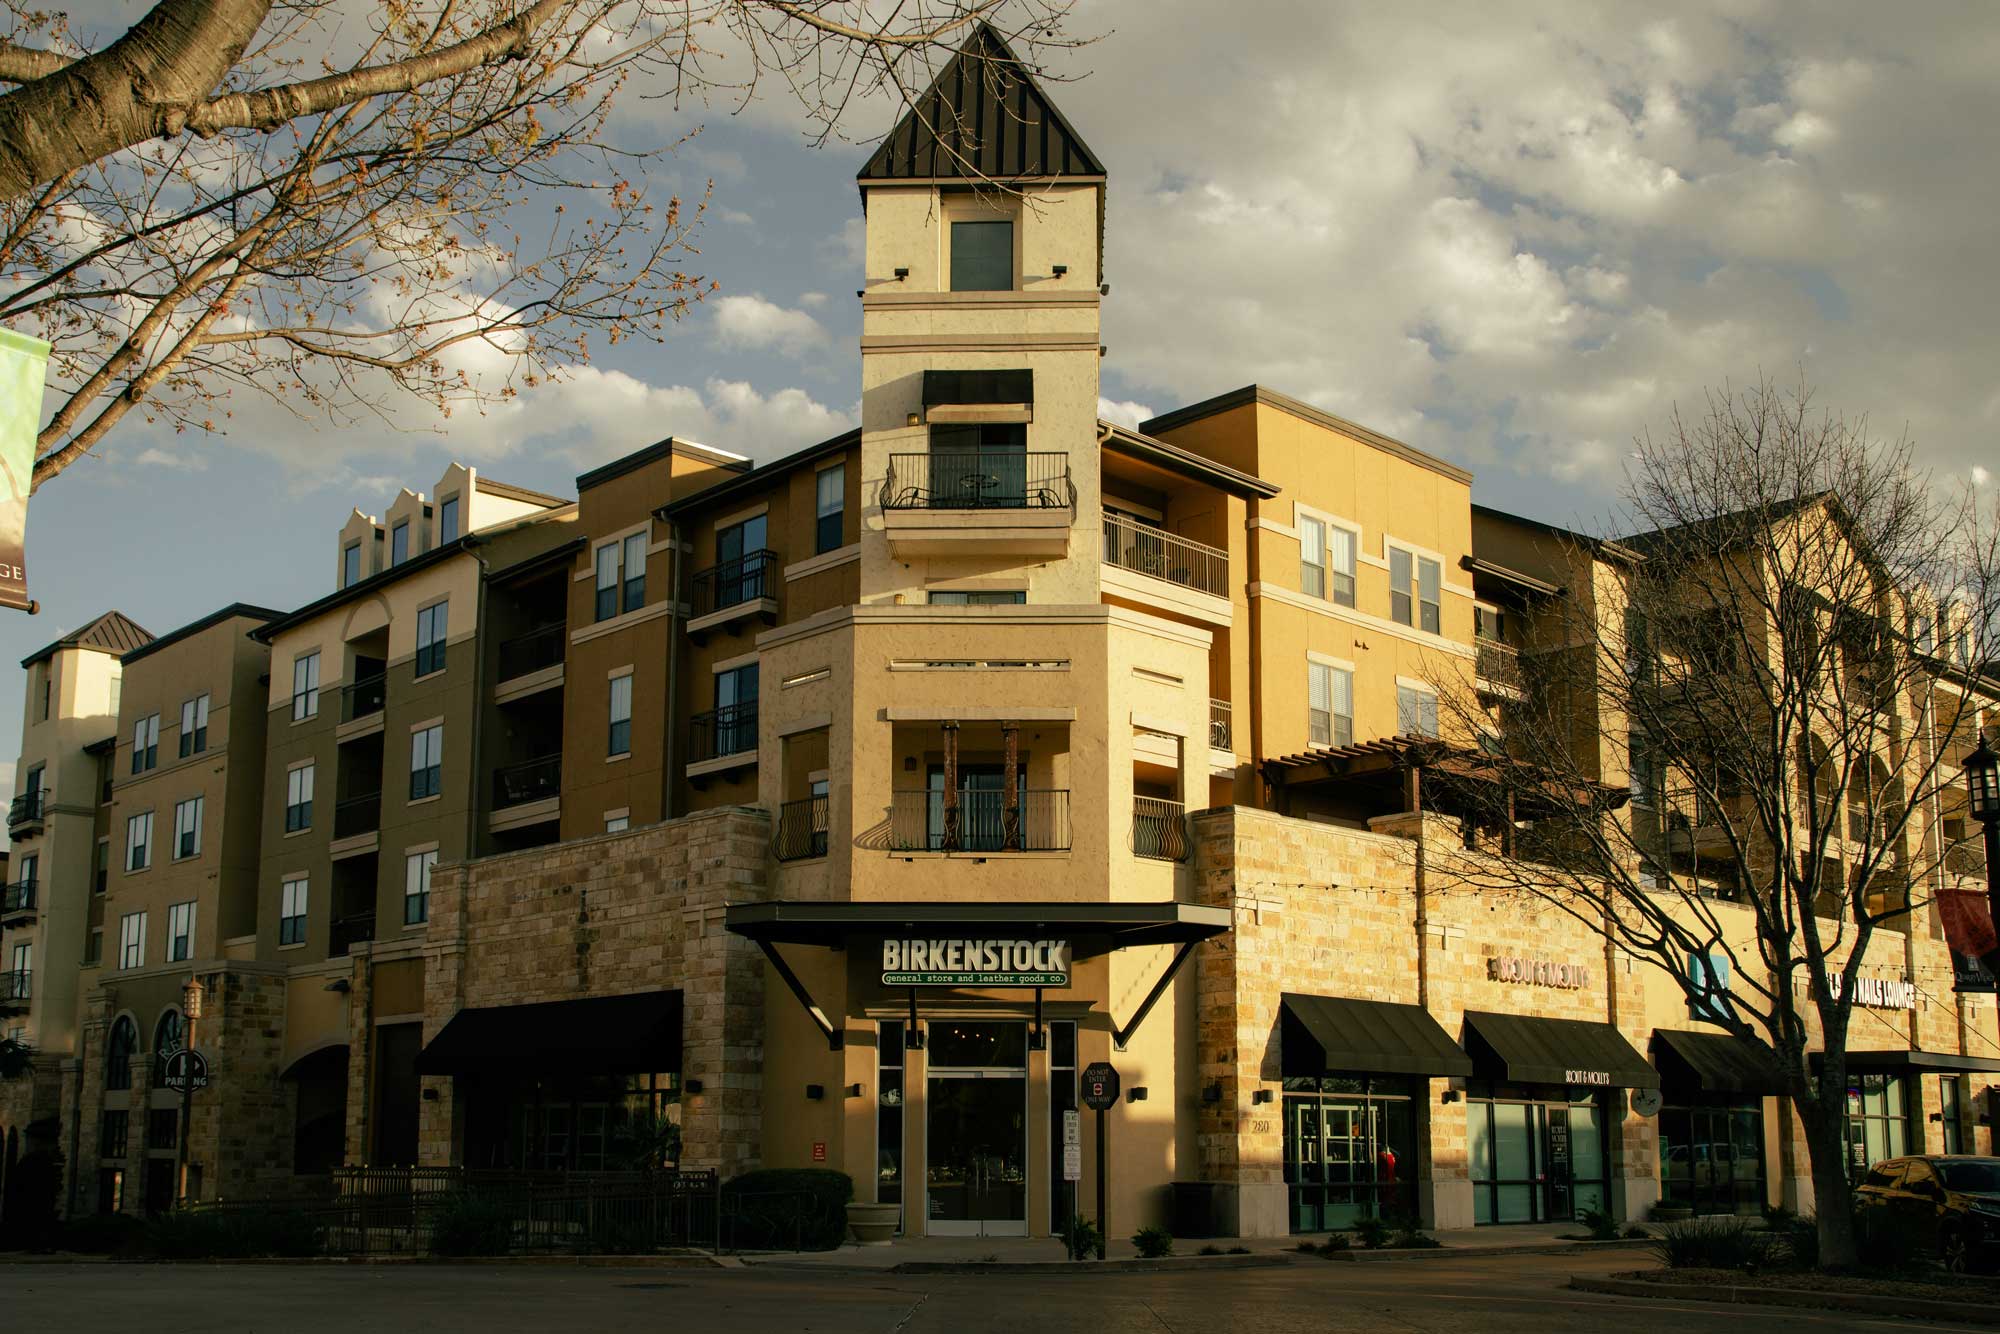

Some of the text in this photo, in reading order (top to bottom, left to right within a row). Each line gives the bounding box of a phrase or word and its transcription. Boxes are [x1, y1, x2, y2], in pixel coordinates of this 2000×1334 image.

[883, 939, 1066, 971] BIRKENSTOCK
[886, 975, 922, 984] general
[978, 974, 1015, 982] leather
[1019, 974, 1046, 984] goods
[1858, 977, 1883, 1006] NAILS
[1884, 980, 1916, 1009] LOUNGE
[1565, 1070, 1583, 1084] SCOUT
[1252, 1119, 1271, 1134] 280
